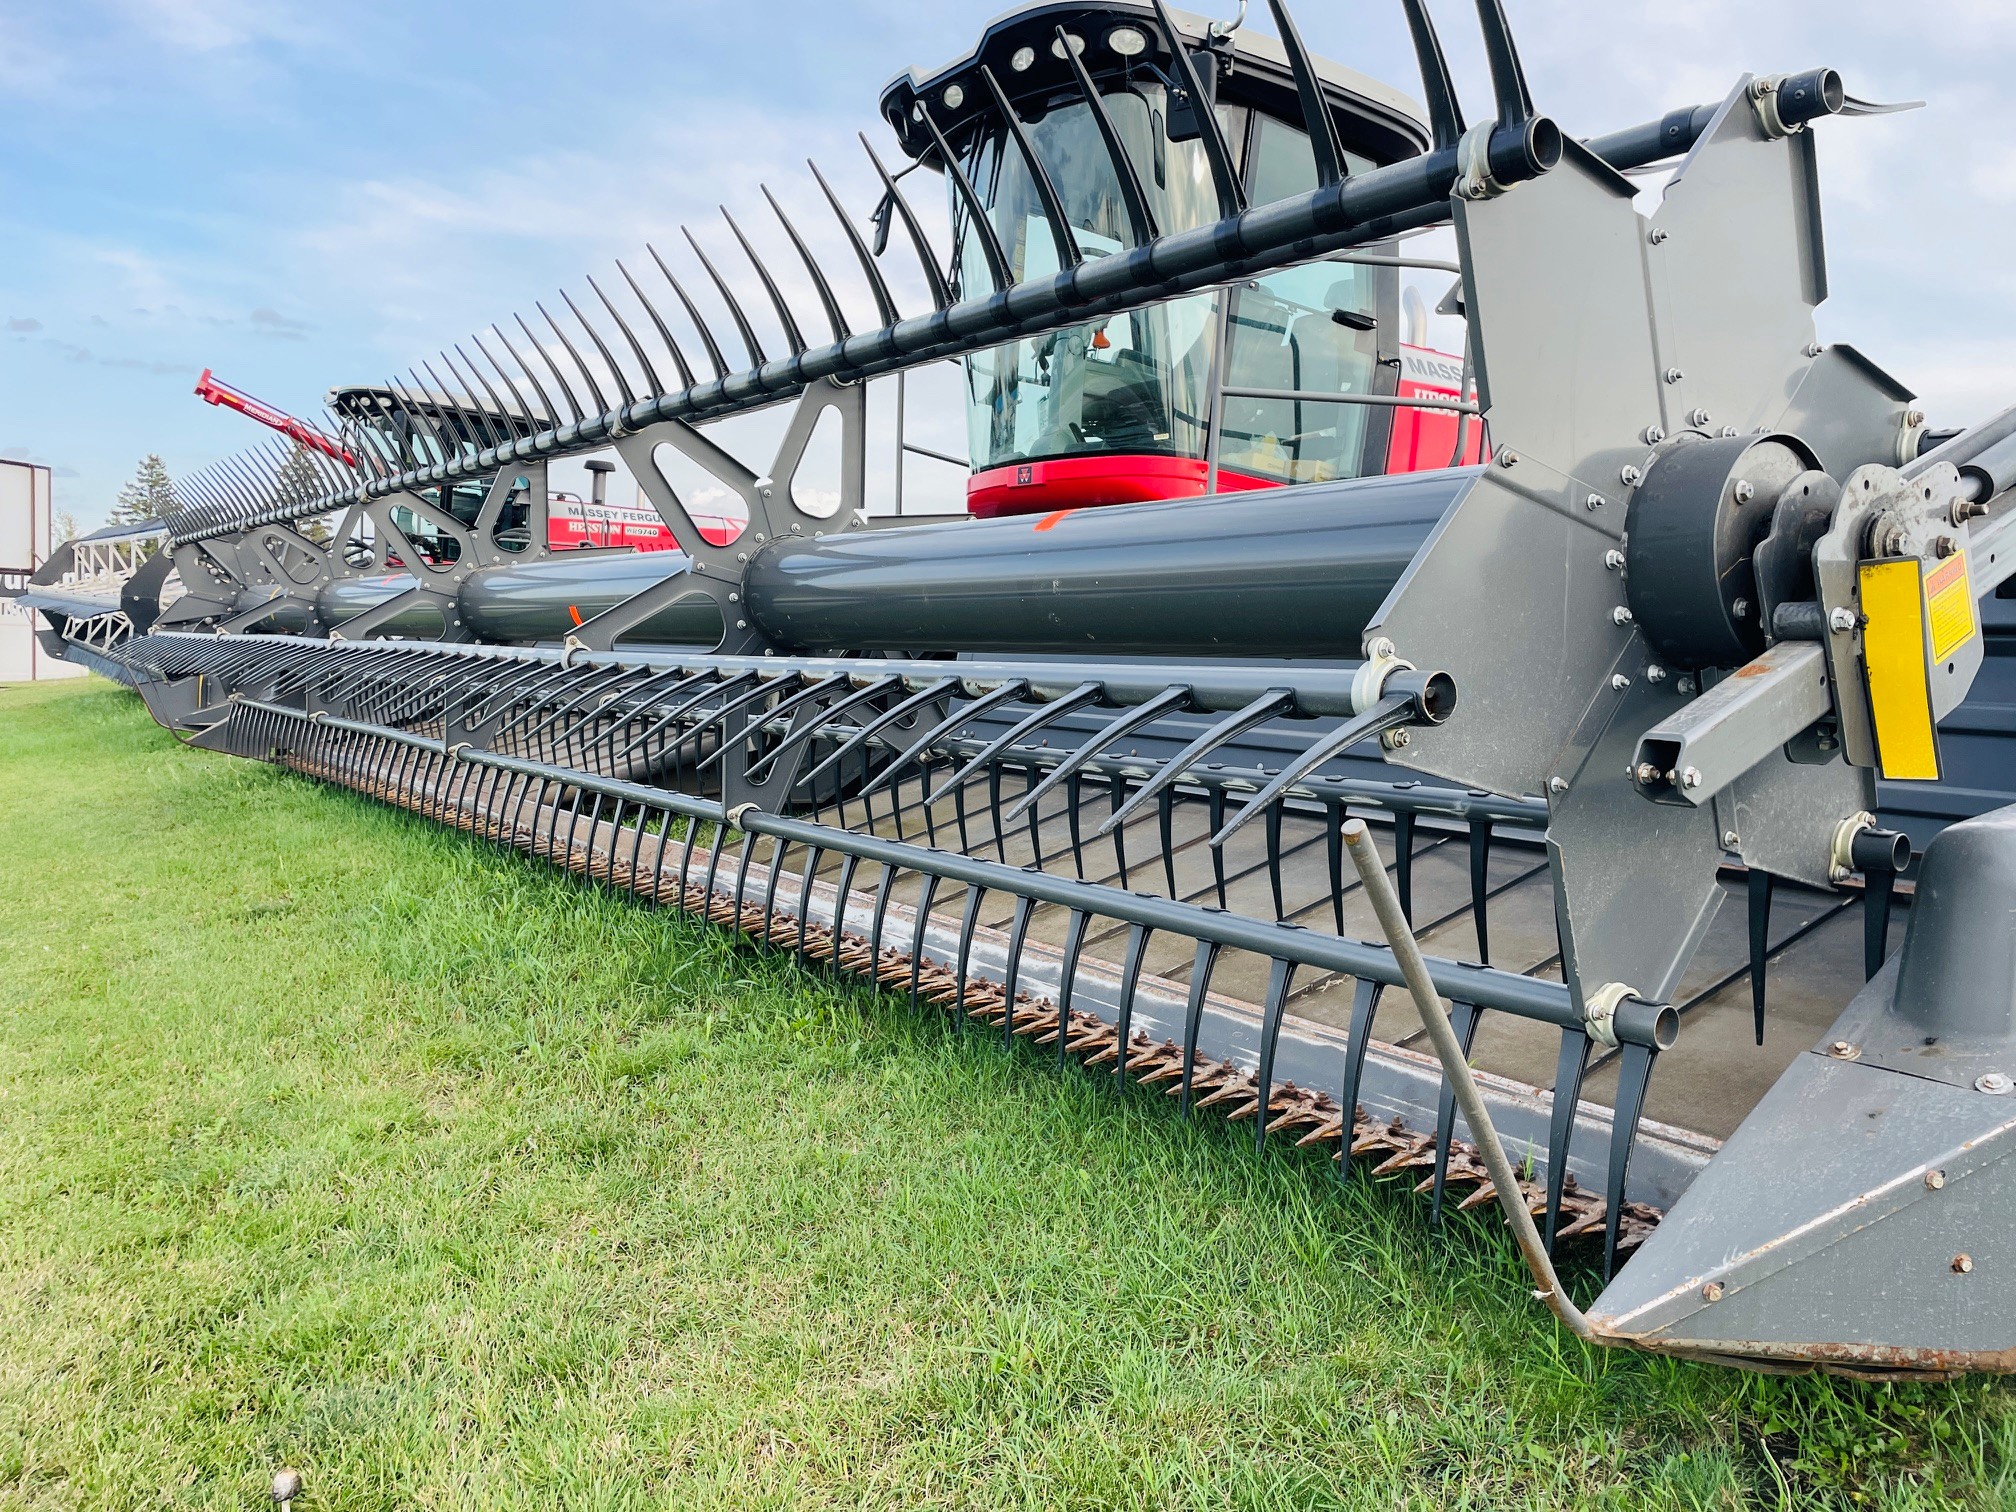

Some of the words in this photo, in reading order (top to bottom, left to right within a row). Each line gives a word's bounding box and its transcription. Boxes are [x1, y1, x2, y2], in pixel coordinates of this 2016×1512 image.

[1406, 356, 1463, 383] MASS
[243, 403, 283, 425] MERIDIAN
[622, 511, 661, 523] FERGU
